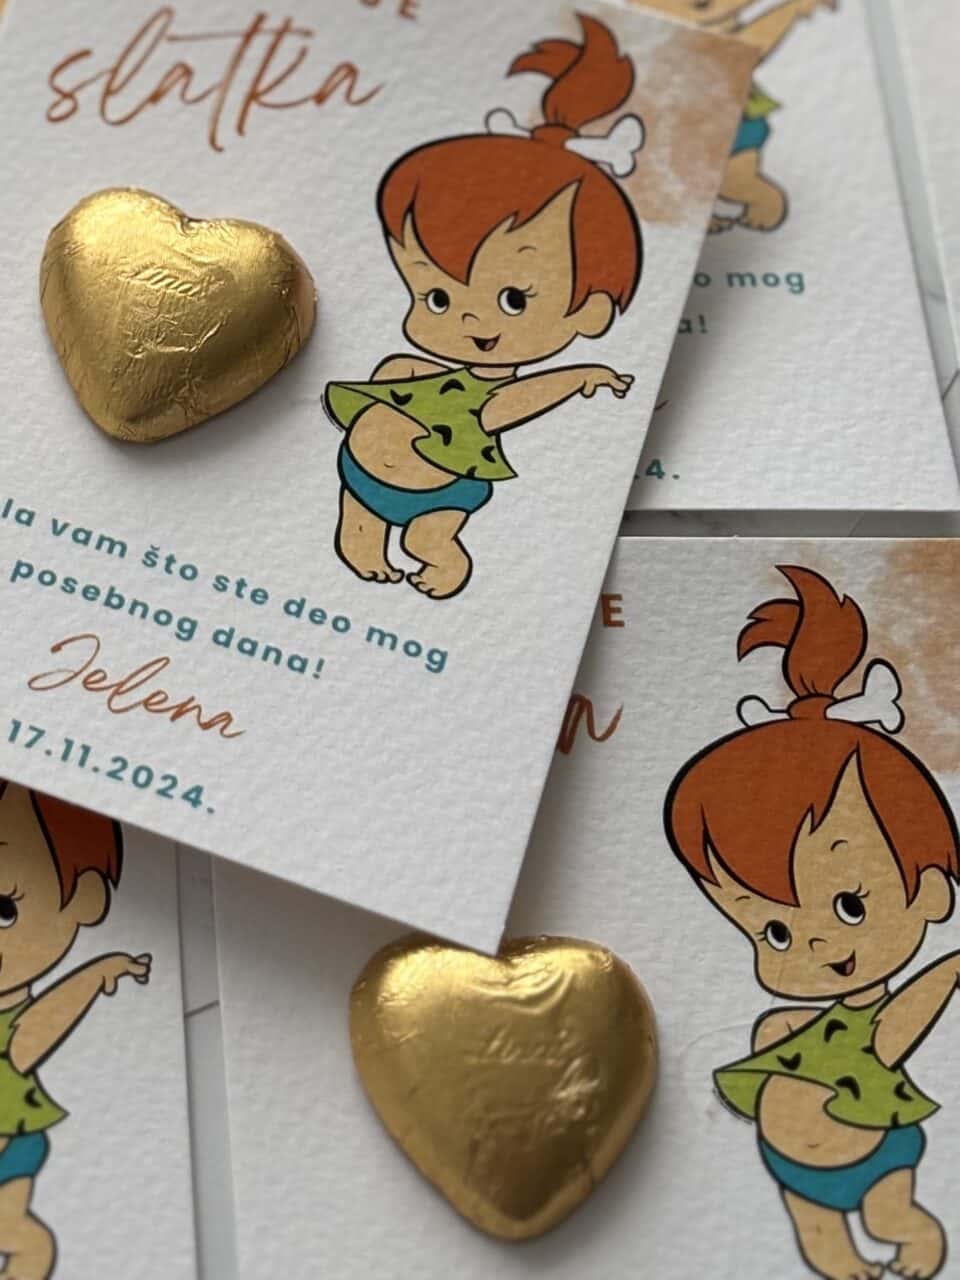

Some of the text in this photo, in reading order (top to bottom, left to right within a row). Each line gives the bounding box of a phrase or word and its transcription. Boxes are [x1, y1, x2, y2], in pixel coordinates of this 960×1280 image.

[45, 5, 386, 154] slatka
[727, 272, 806, 295] mog
[9, 559, 326, 680] posebnog dana!
[50, 517, 129, 558] vam
[141, 544, 199, 581] što
[212, 574, 270, 606] ste
[283, 597, 352, 634] deo
[365, 625, 450, 674] mog
[26, 633, 246, 739] Jelena
[7, 718, 216, 815] 17.11.2024.
